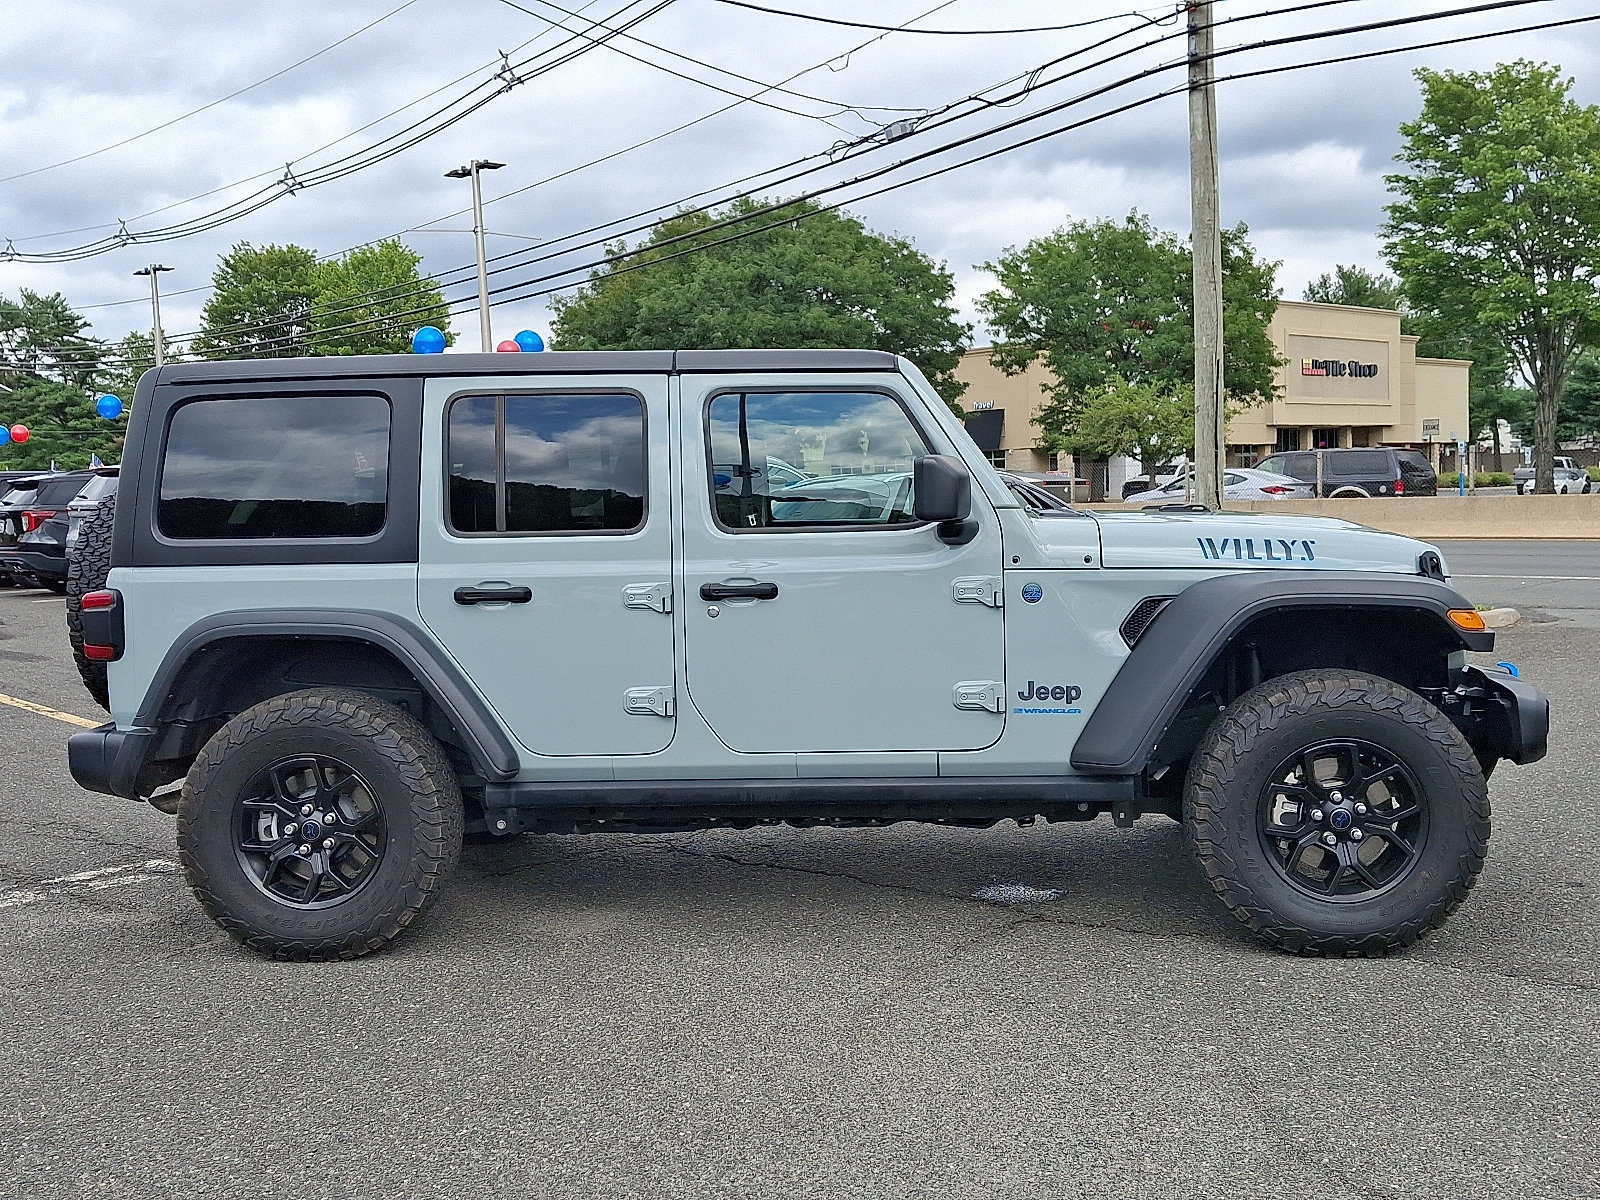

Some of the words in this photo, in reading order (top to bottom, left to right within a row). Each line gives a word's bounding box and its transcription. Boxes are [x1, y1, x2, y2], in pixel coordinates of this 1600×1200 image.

[1325, 360, 1346, 376] Tile
[1348, 361, 1378, 378] Shop
[973, 400, 994, 410] Travel
[1196, 537, 1316, 561] WILLYS
[1018, 681, 1082, 705] Jeep
